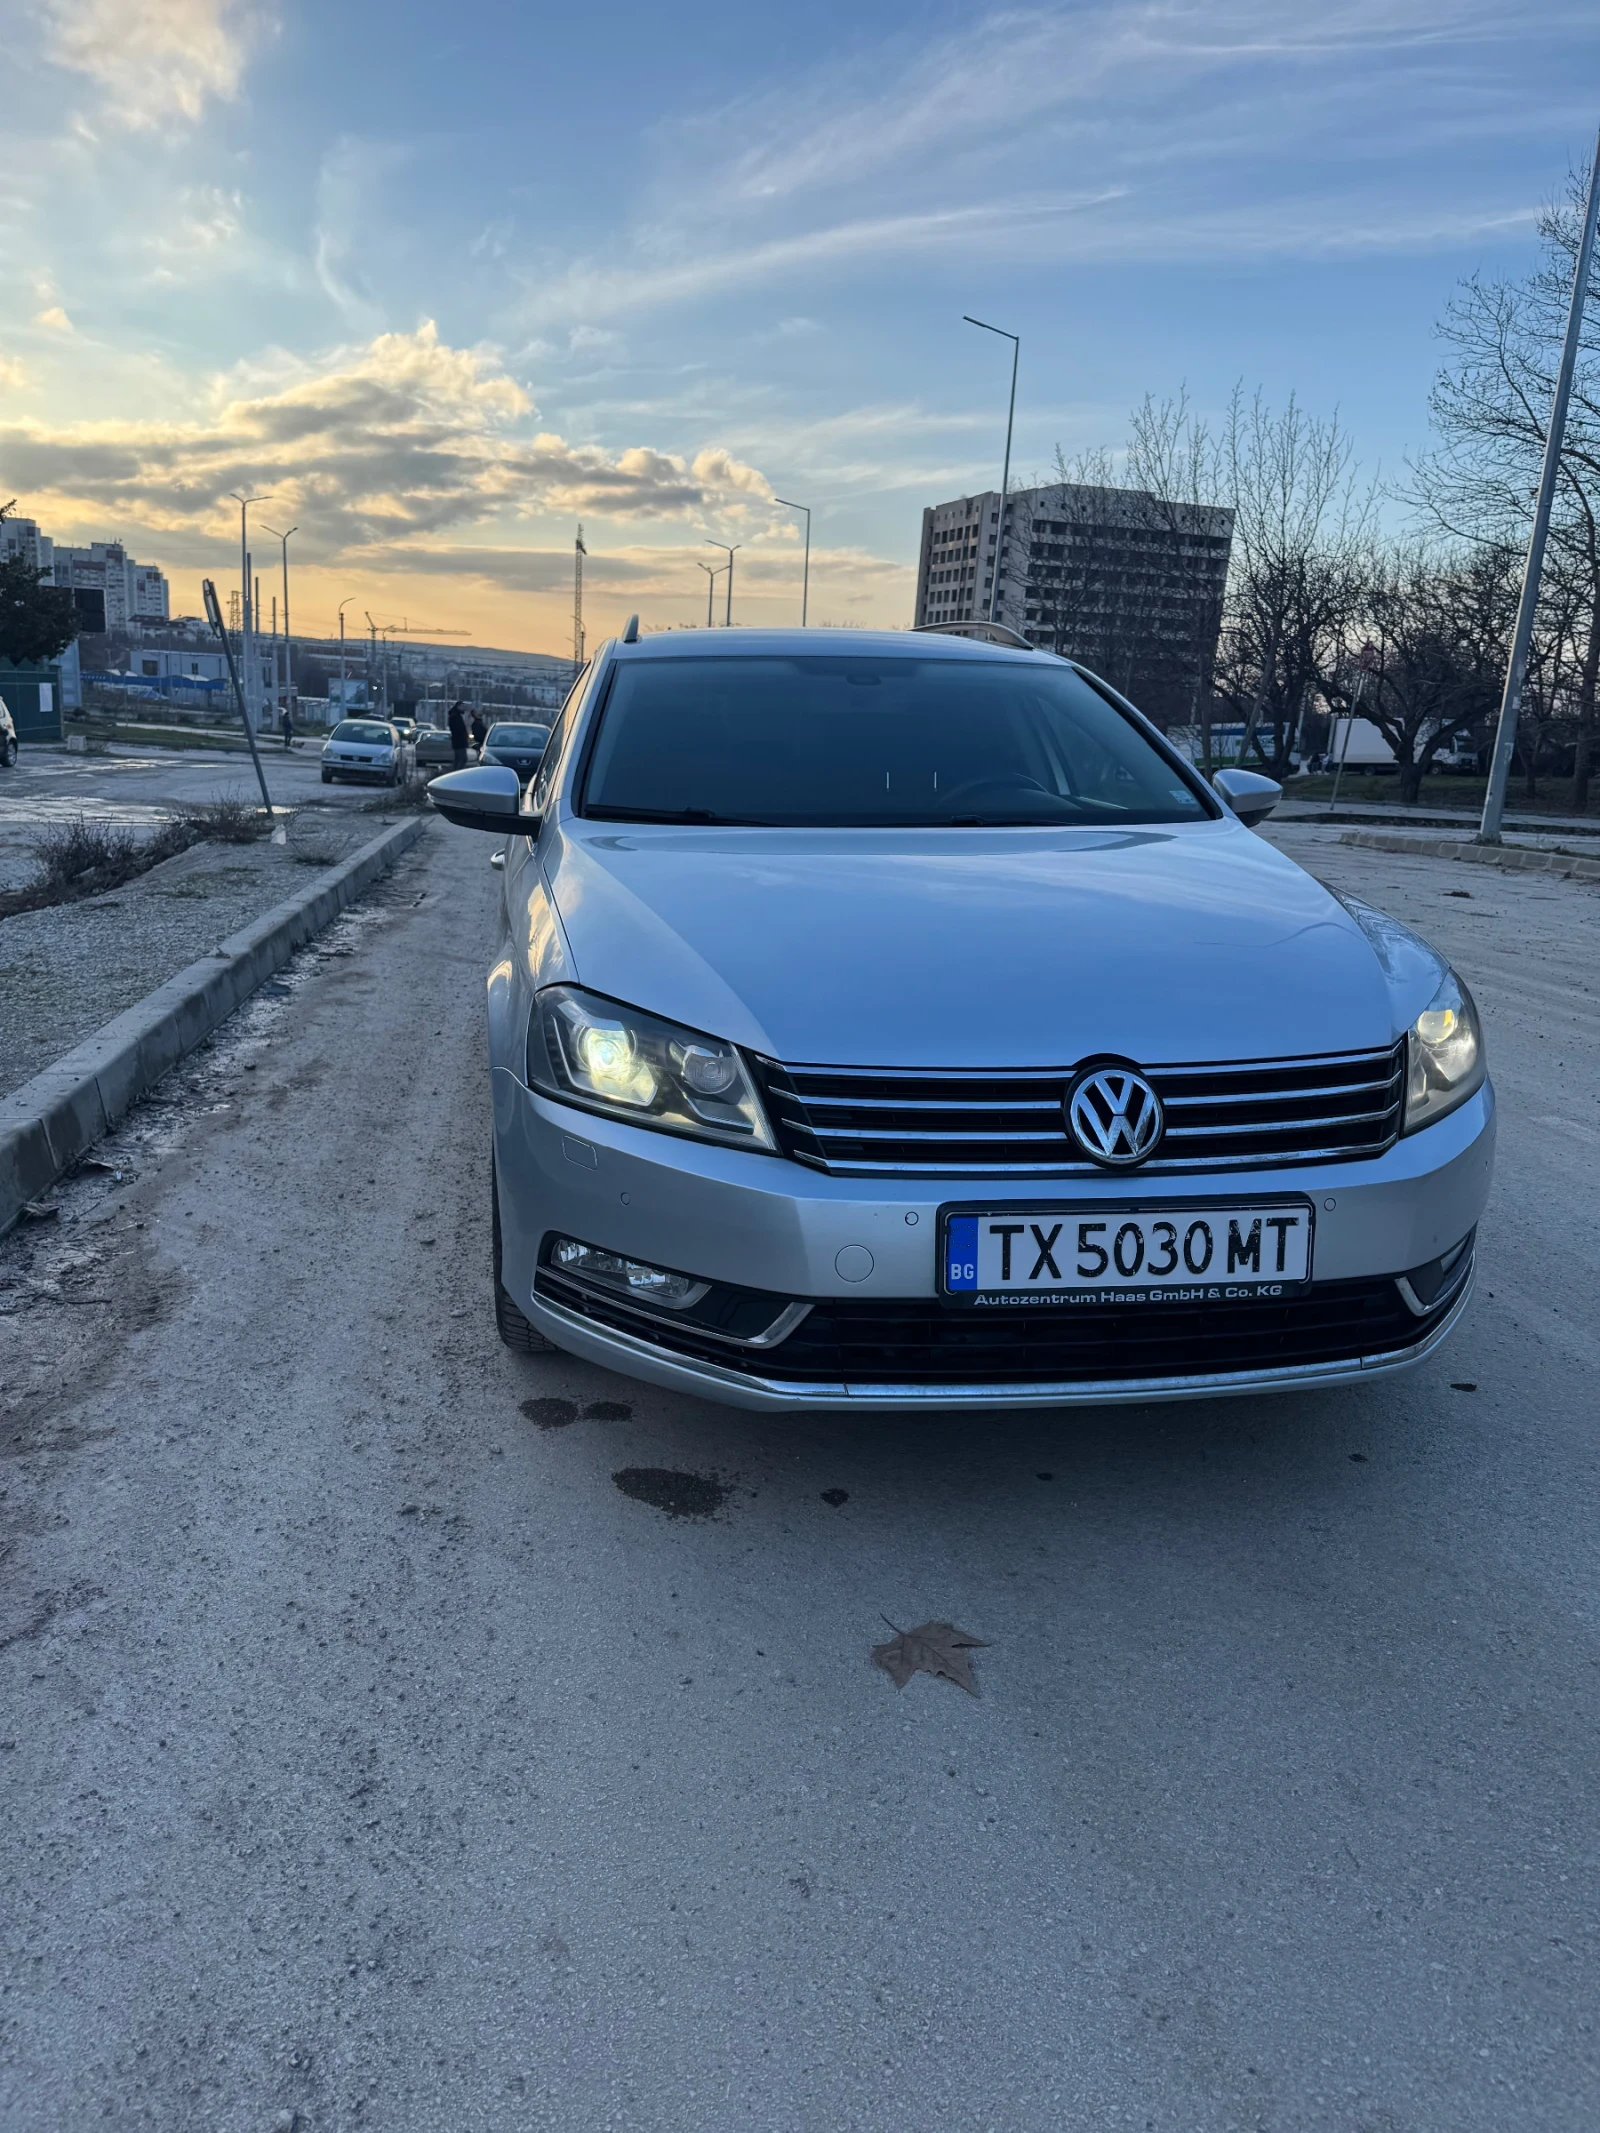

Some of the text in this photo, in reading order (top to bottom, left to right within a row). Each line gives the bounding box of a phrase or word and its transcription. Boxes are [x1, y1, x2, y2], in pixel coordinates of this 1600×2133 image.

[1070, 1069, 1160, 1159] VW
[989, 1217, 1300, 1281] TX 5030 MT
[950, 1263, 975, 1281] BG
[973, 1285, 1283, 1306] Autozentrum Haas GmbH & Co. KG
